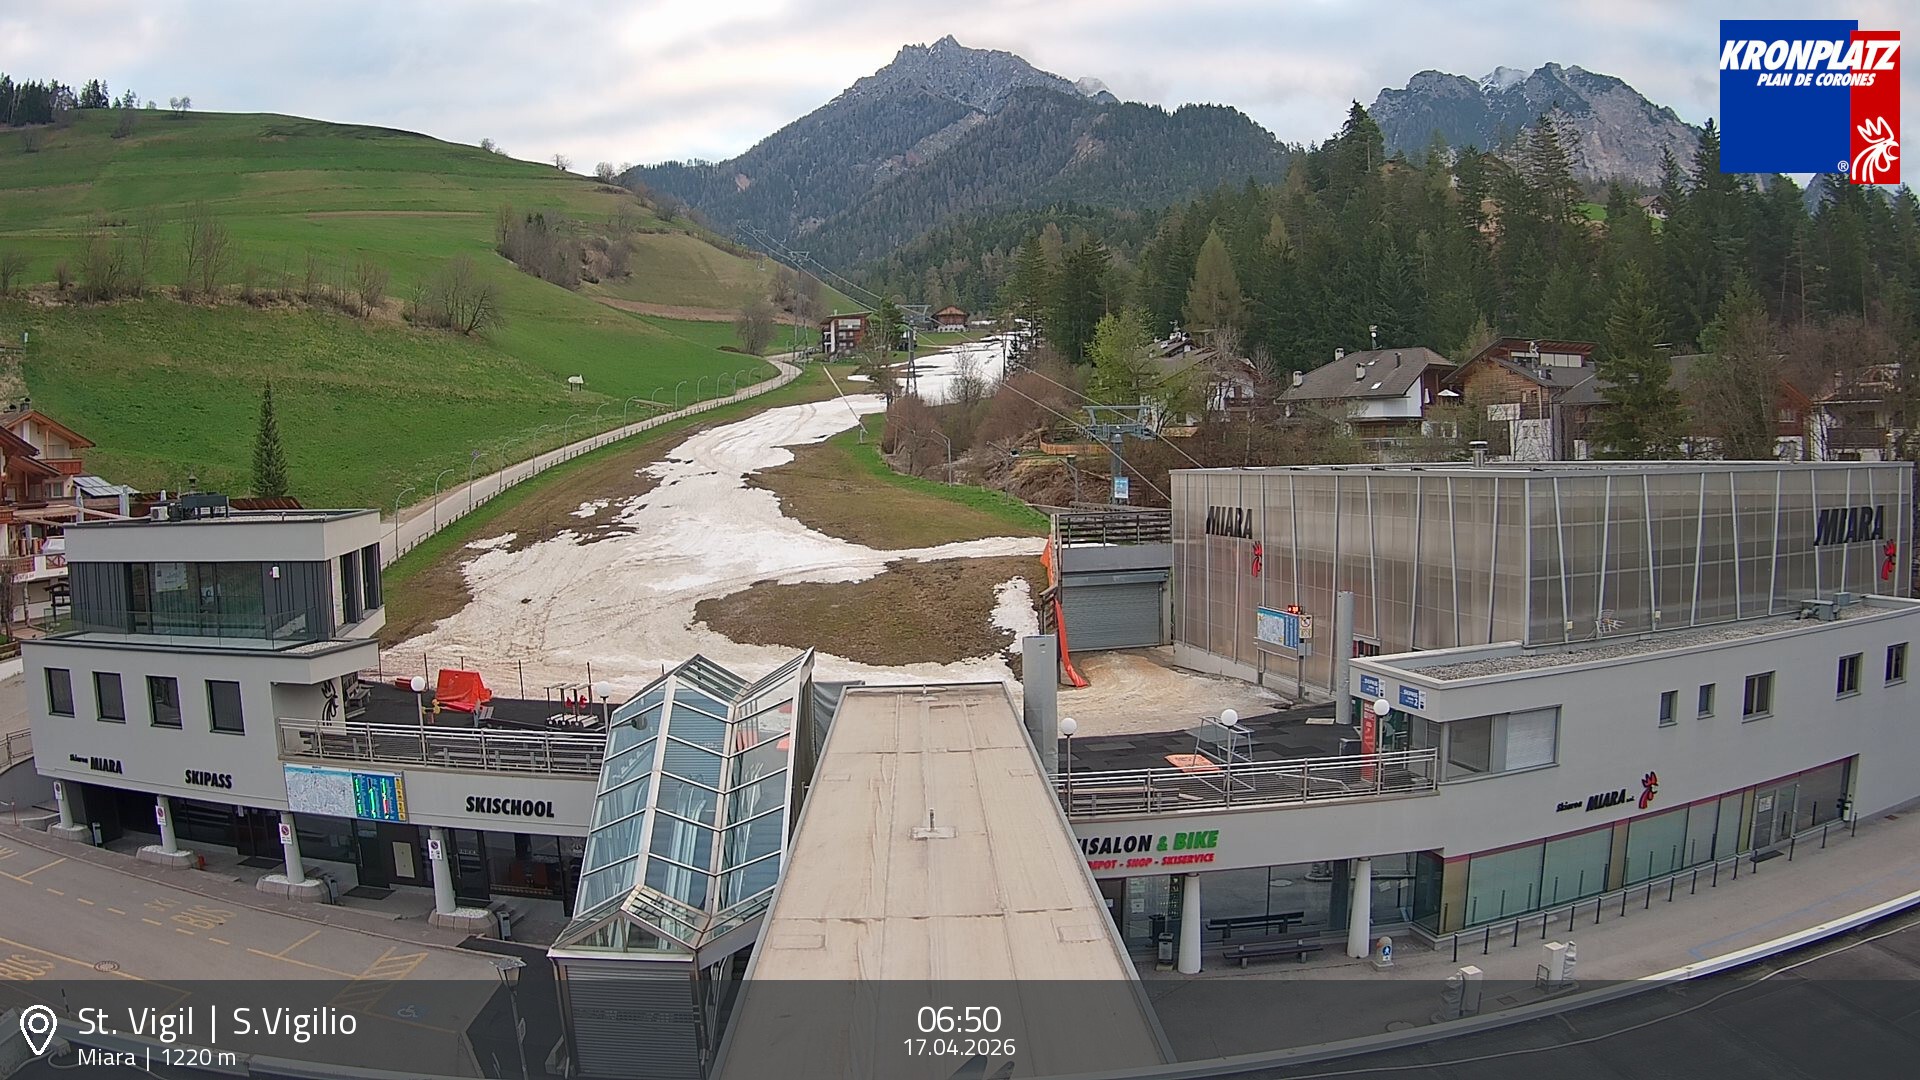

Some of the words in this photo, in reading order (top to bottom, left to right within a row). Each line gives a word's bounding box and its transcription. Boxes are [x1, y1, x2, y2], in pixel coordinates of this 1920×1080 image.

[1206, 506, 1253, 539] MIARA
[1814, 505, 1884, 546] MIARA
[90, 756, 123, 774] MIARA
[185, 770, 232, 789] SKIPASS
[466, 796, 555, 818] SKISCHOOL
[1585, 789, 1626, 812] MIARA
[1077, 835, 1152, 855] ISALON
[1156, 836, 1168, 851] &
[1173, 830, 1219, 850] BIKE
[1126, 858, 1153, 869] SHOP
[1161, 853, 1215, 866] SKISERVICE
[170, 905, 236, 929] BUS
